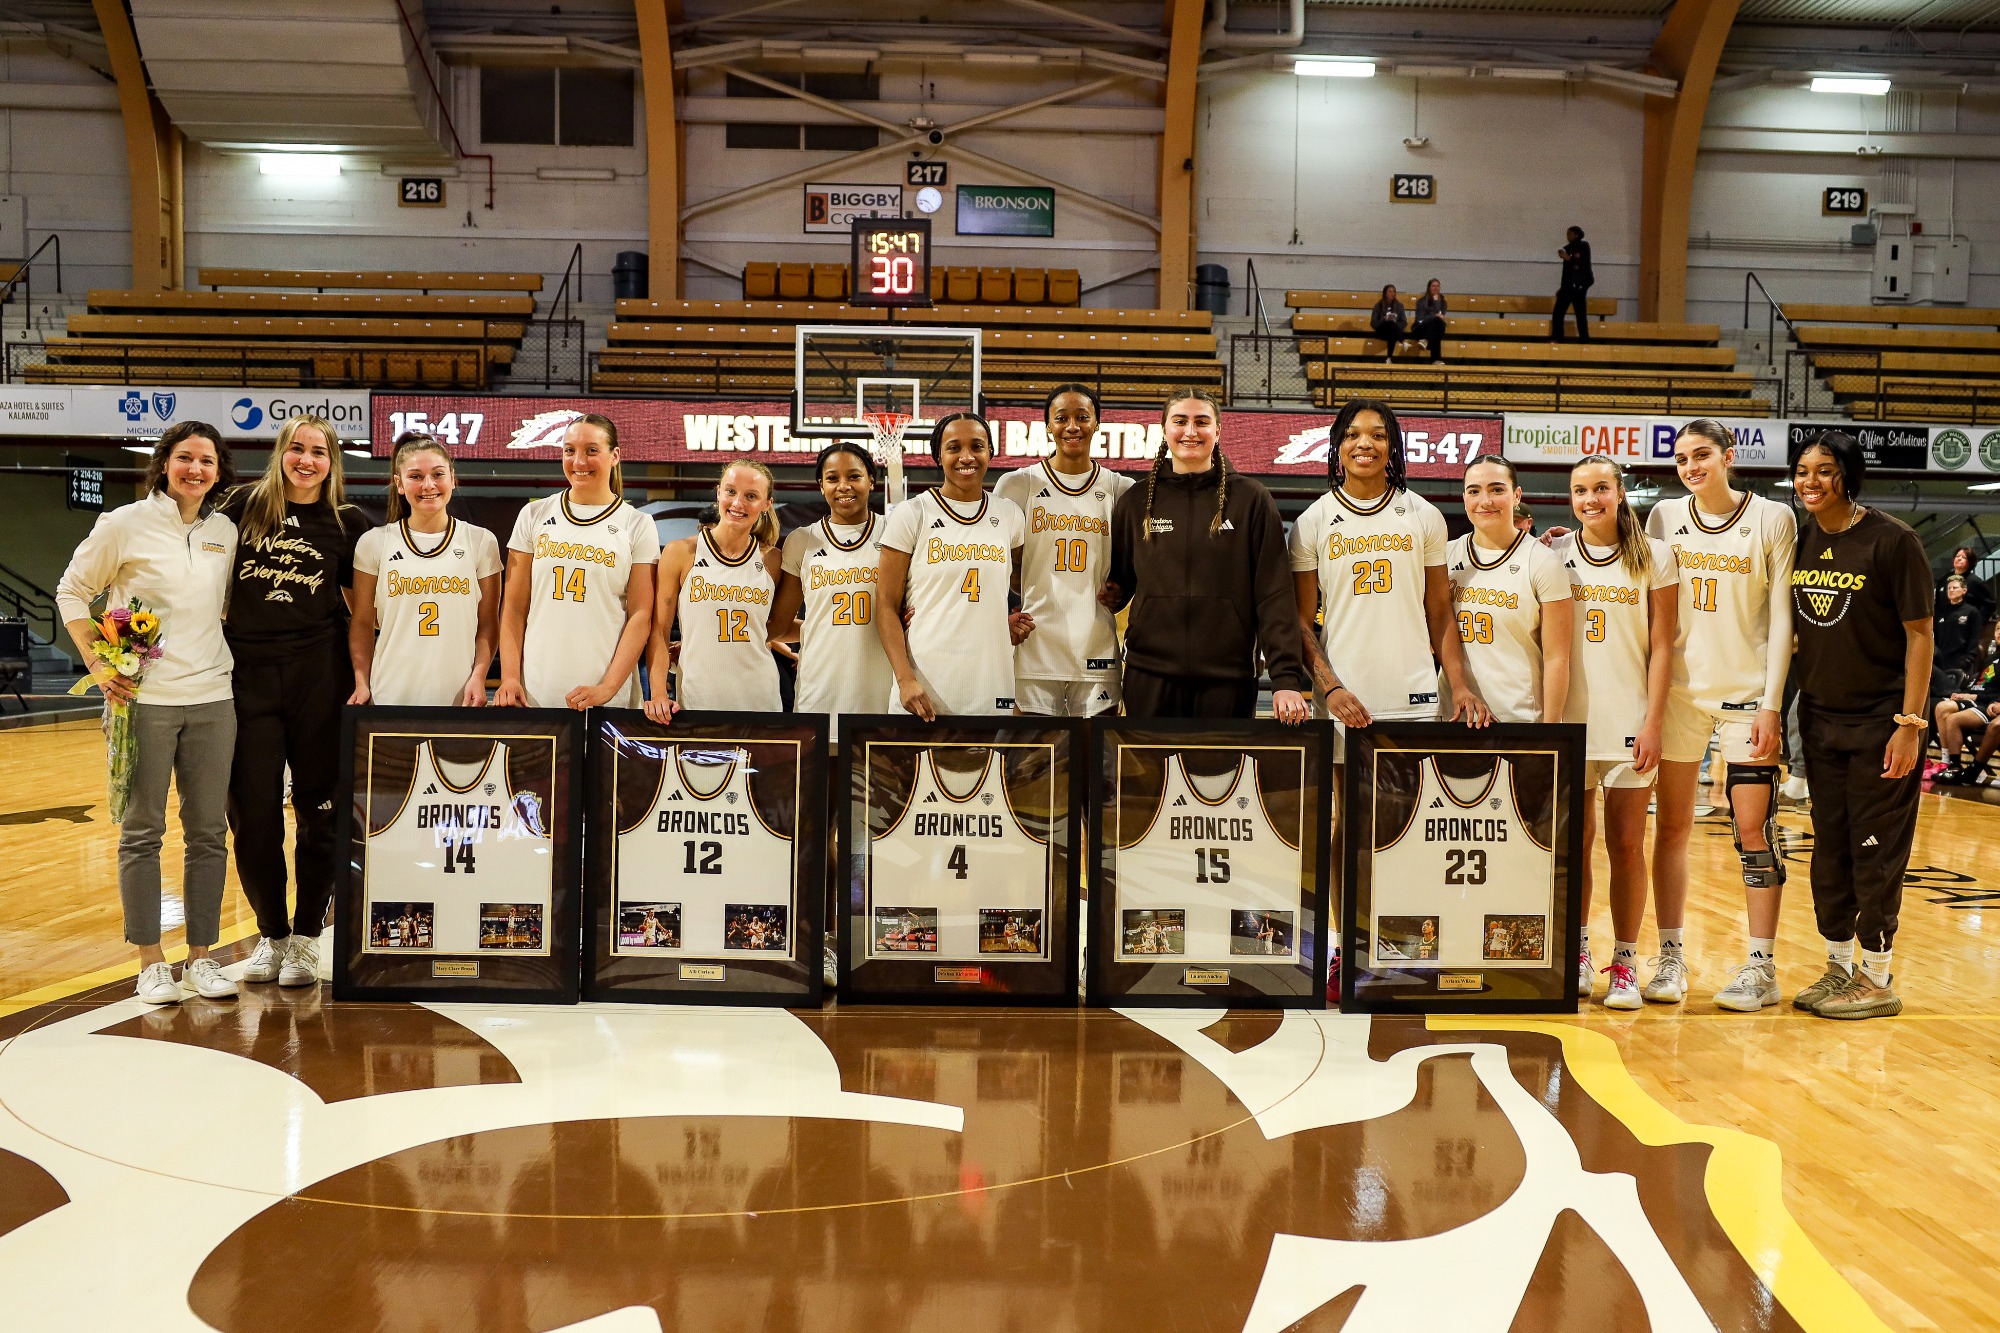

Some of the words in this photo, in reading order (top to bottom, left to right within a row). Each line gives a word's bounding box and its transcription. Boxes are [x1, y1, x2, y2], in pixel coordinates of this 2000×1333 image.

[911, 165, 944, 183] 217
[1397, 178, 1429, 196] 218
[405, 182, 438, 200] 216
[831, 193, 899, 207] BIGGBY
[975, 195, 1050, 210] BRONSON
[1829, 191, 1861, 209] 219
[871, 233, 920, 254] 15:47
[871, 256, 913, 294] 30
[8, 412, 49, 420] KALAMAZOO
[14, 402, 33, 410] HOTEL
[34, 402, 40, 410] &
[41, 402, 65, 411] SUITES
[269, 399, 363, 421] Gordon
[389, 412, 484, 445] 15:47
[1507, 424, 1579, 448] tropical
[1581, 426, 1640, 456] CAFE
[1858, 429, 1885, 449] Office
[1887, 430, 1927, 447] Solutions
[1542, 445, 1579, 455] SMOOTHIE
[80, 480, 101, 492] 112-117
[80, 491, 103, 504] 212-213
[1032, 506, 1109, 536] Broncos
[245, 530, 325, 560] Western
[535, 533, 616, 568] Broncos
[927, 537, 1006, 565] Broncos
[1055, 538, 1088, 572] 10
[1329, 531, 1413, 560] Broncos
[240, 560, 325, 595] Everybody
[388, 570, 471, 598] Broncos
[553, 566, 586, 602] 14
[690, 575, 769, 606] Broncos
[810, 564, 879, 590] Bronco
[960, 568, 981, 602] 4
[1352, 559, 1393, 595] 23
[1791, 569, 1867, 590] BRONCOS
[832, 590, 872, 626] 20
[1570, 584, 1640, 605] roncos
[1691, 577, 1718, 612] 11
[419, 602, 440, 636] 2
[716, 608, 751, 642] 12
[1457, 610, 1494, 645] 33
[1586, 609, 1606, 642] 3
[417, 804, 501, 829] BRONCOS
[657, 810, 750, 836] BRONCOS
[914, 812, 1003, 838] BRONCOS
[1170, 815, 1254, 842] BRONCOS
[1424, 817, 1508, 842] BRONCOS
[443, 837, 476, 874] 14
[683, 840, 723, 875] 12
[947, 844, 969, 880] 4
[1194, 848, 1231, 884] 15
[1445, 849, 1487, 885] 23
